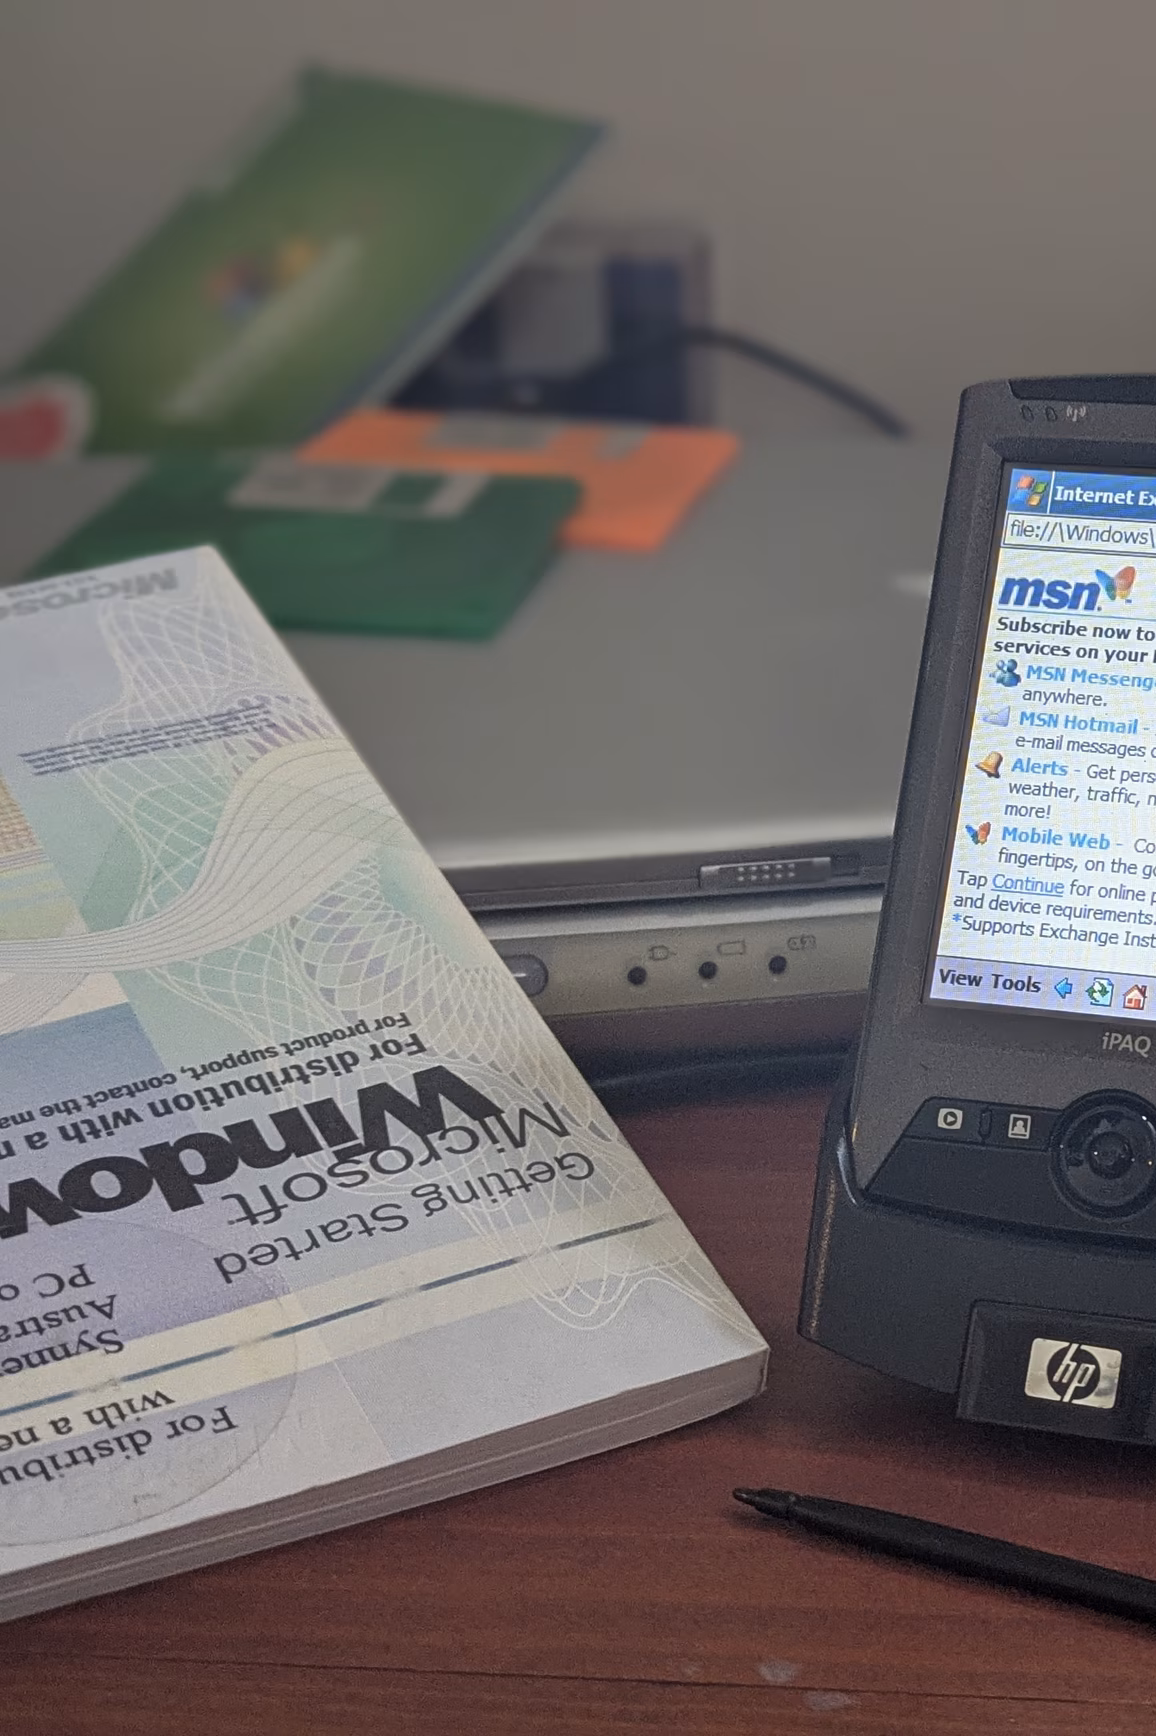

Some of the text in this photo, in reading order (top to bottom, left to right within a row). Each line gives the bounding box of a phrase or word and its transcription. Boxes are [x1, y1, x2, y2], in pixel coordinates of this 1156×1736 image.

[1054, 485, 1134, 507] Internet
[998, 575, 1102, 612] msn
[997, 617, 1087, 637] Subscribe
[1092, 624, 1131, 641] now
[1136, 627, 1154, 643] to
[993, 641, 1072, 660] services
[1076, 645, 1098, 661] on
[1104, 647, 1147, 667] your
[1026, 665, 1066, 683] MSN
[1022, 687, 1108, 707] anywhere.
[1019, 711, 1058, 728] MSN
[1063, 713, 1138, 735] Hotmail
[1015, 734, 1063, 752] e-mail
[1066, 739, 1146, 760] messages
[1011, 758, 1068, 777] Alerts
[1086, 764, 1116, 782] Get
[1008, 781, 1079, 803] weather,
[1086, 785, 1140, 809] traffic,
[1003, 802, 1052, 820] more!
[1001, 827, 1063, 847] Mobile
[1068, 831, 1110, 851] Web
[998, 847, 1078, 872] fingertips,
[1084, 857, 1105, 873] on
[1110, 857, 1137, 876] the
[957, 870, 988, 890] Tap
[991, 873, 1064, 897] Continue
[1069, 878, 1093, 897] for
[1097, 881, 1146, 901] online
[953, 892, 984, 910] and
[988, 896, 1041, 915] device
[1039, 923, 1119, 947] Exchange
[938, 969, 1041, 993] View Tools
[374, 1012, 412, 1034] For
[284, 1019, 369, 1056] product
[369, 1032, 427, 1062] For
[1101, 1032, 1151, 1058] iPAQ
[180, 1044, 279, 1081] support,
[86, 1072, 177, 1109] contact
[148, 1050, 360, 1118] distribution
[39, 1095, 82, 1118] the
[24, 1125, 49, 1150] a
[59, 1104, 144, 1145] with
[221, 1102, 570, 1226] Microsoft
[213, 1151, 595, 1284] Getting Started
[32, 1263, 96, 1299] PC
[83, 1390, 176, 1430] with
[165, 1405, 238, 1439] For
[48, 1416, 73, 1437] a
